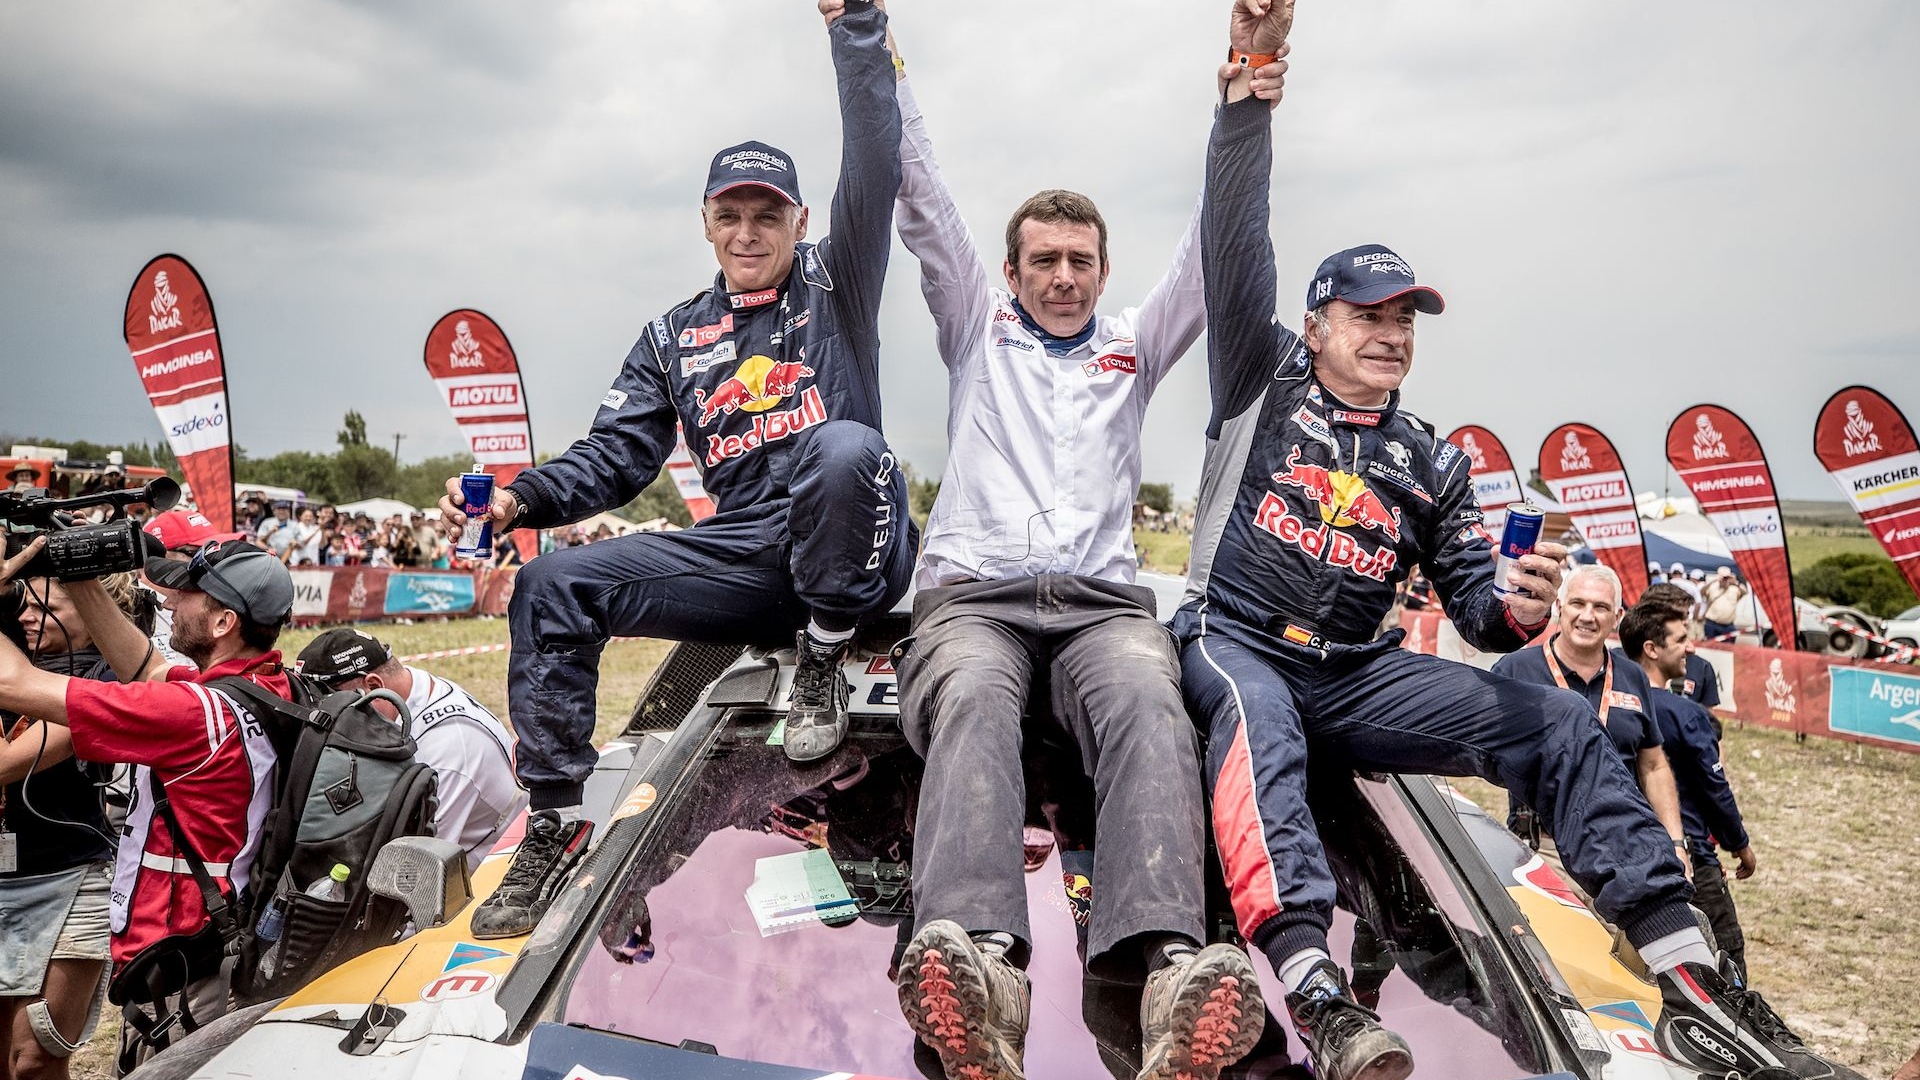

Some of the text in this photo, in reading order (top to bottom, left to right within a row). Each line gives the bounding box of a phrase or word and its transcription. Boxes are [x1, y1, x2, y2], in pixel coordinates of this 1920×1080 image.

[721, 150, 787, 169] BFGoodrich
[731, 160, 780, 172] RACING
[743, 292, 777, 304] TOTAL
[1315, 277, 1334, 301] 1st
[148, 307, 183, 335] DAKAR
[699, 321, 732, 342] TOTL
[141, 348, 215, 379] HIMOINSA
[449, 350, 486, 369] DAKAR
[1103, 356, 1136, 371] TOTAL
[452, 386, 516, 406] MOTUL
[170, 411, 224, 438] sodexo
[705, 384, 828, 468] Red Bull
[473, 435, 525, 451] MOTUL
[1692, 441, 1730, 461] DAKAR
[1842, 432, 1883, 458] DAKAR
[1369, 461, 1416, 486] PEUGEOT
[1560, 455, 1593, 472] DAKAR
[1692, 475, 1766, 493] HIMOINSA
[1853, 466, 1920, 491] KÄRCHER
[1565, 481, 1623, 502] MOTUL
[465, 503, 486, 514] Red
[1253, 490, 1398, 582] Red Bull
[1588, 522, 1635, 538] MOTUL
[1724, 523, 1777, 537] sodexo
[1508, 542, 1532, 555] Red
[1310, 636, 1321, 648] C.
[1765, 691, 1797, 714] DAKAR
[422, 704, 467, 725] 2018
[1687, 1025, 1738, 1066] sparco
